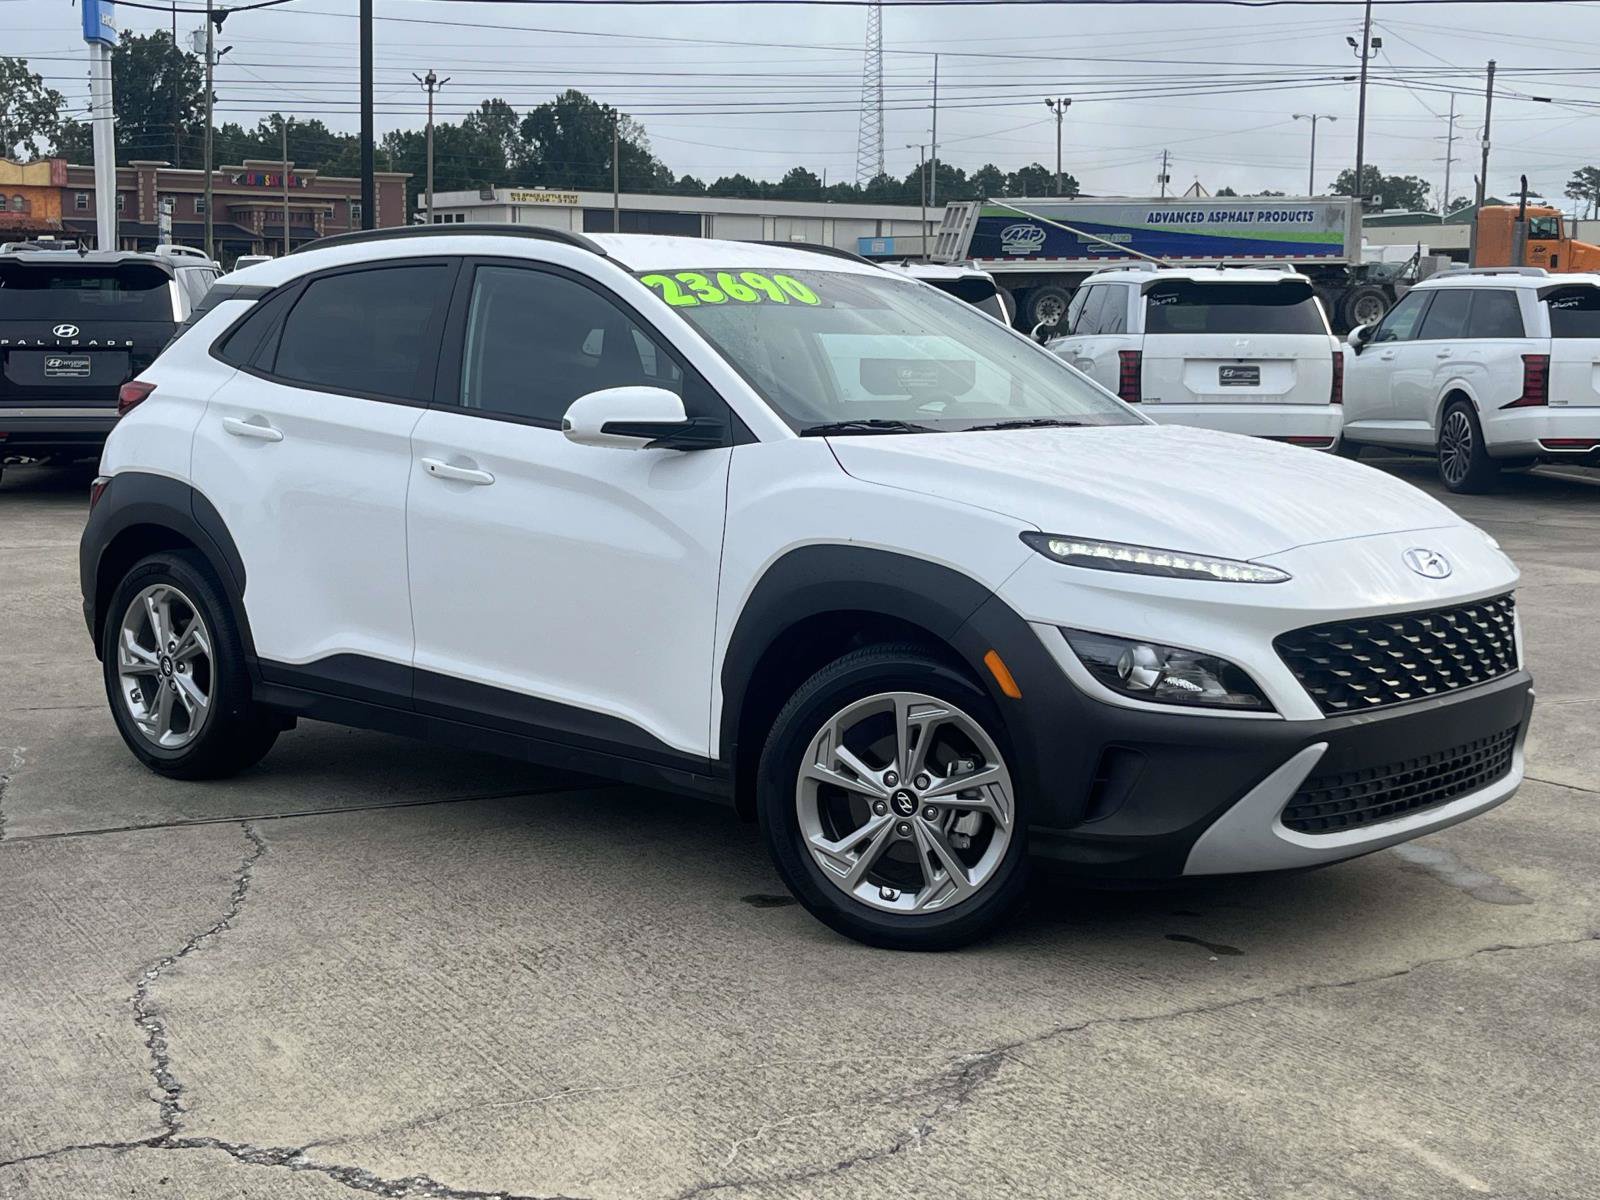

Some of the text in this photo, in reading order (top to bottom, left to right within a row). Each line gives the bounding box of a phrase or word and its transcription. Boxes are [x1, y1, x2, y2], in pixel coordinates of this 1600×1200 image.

[1146, 210, 1314, 224] ADVANCED ASPHALT PRODUCTS
[640, 272, 821, 306] 23690
